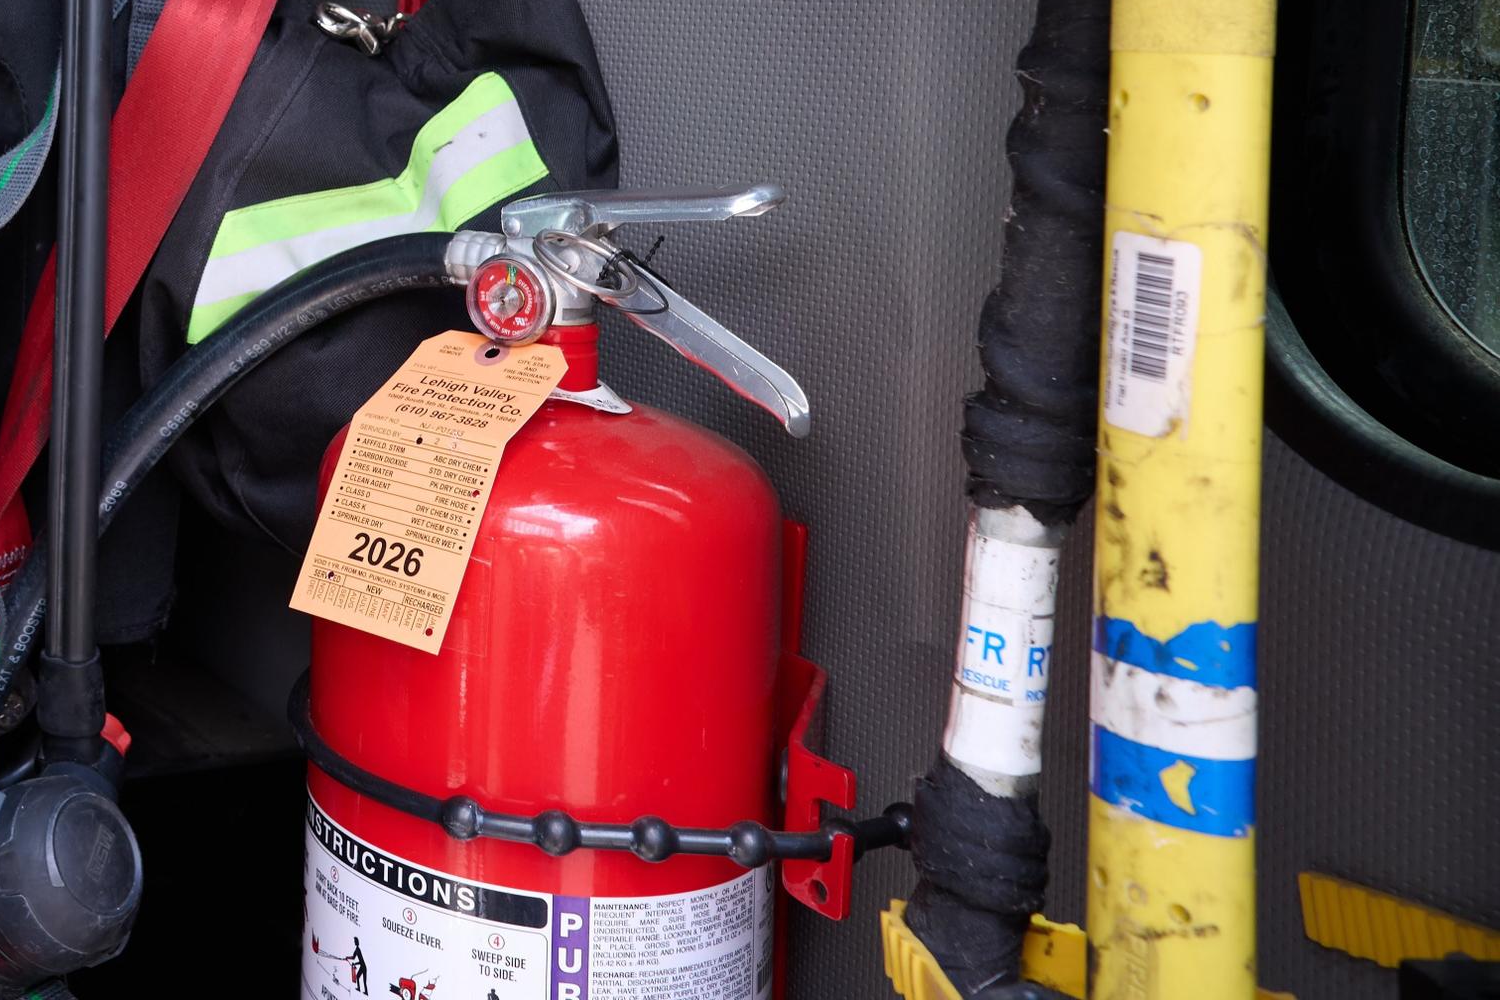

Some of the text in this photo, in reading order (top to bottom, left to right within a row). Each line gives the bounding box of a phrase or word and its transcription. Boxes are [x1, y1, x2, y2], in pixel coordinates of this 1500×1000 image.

[418, 375, 516, 402] Lehigh Valley
[391, 383, 527, 416] Fire Protection Co.
[394, 403, 489, 428] (610) 967-3828
[357, 449, 409, 468] CARBON DIOXIDE
[432, 454, 482, 472] ABC DRY CHEM
[348, 473, 391, 490] CLEAN AGENT
[371, 466, 394, 478] WATER
[442, 470, 458, 480] DRY
[456, 473, 478, 485] CHEM
[100, 480, 128, 512] 2069
[344, 485, 366, 497] CLASS
[428, 480, 440, 489] PK
[438, 482, 454, 493] DRY
[340, 497, 367, 511] CLASS K
[414, 504, 429, 514] DRY
[428, 507, 449, 519] CHEM
[433, 495, 469, 510] FIRE HOSE
[335, 510, 384, 529] SPRINKLER DRY
[409, 516, 426, 527] WET
[424, 520, 445, 532] CHEM
[403, 528, 456, 550] SPRINKLER WET
[346, 529, 426, 579] 2026
[312, 568, 445, 615] SERVED NEW RECHARGED
[367, 598, 379, 617] JUNE
[381, 602, 391, 619] MAY
[963, 668, 1011, 692] ESCUE
[307, 798, 476, 911] NSTRUCTIONS
[656, 898, 686, 909] INSPECT
[690, 891, 718, 903] MONTHLY
[722, 887, 730, 896] OR
[593, 911, 635, 919] FREQUENT
[645, 908, 683, 917] INTERVALS
[691, 902, 709, 912] WHEN
[382, 916, 444, 951] SQUEEZE LEVER.
[471, 948, 527, 970] SWEEP SIDE
[479, 963, 518, 983] TO SIDE.
